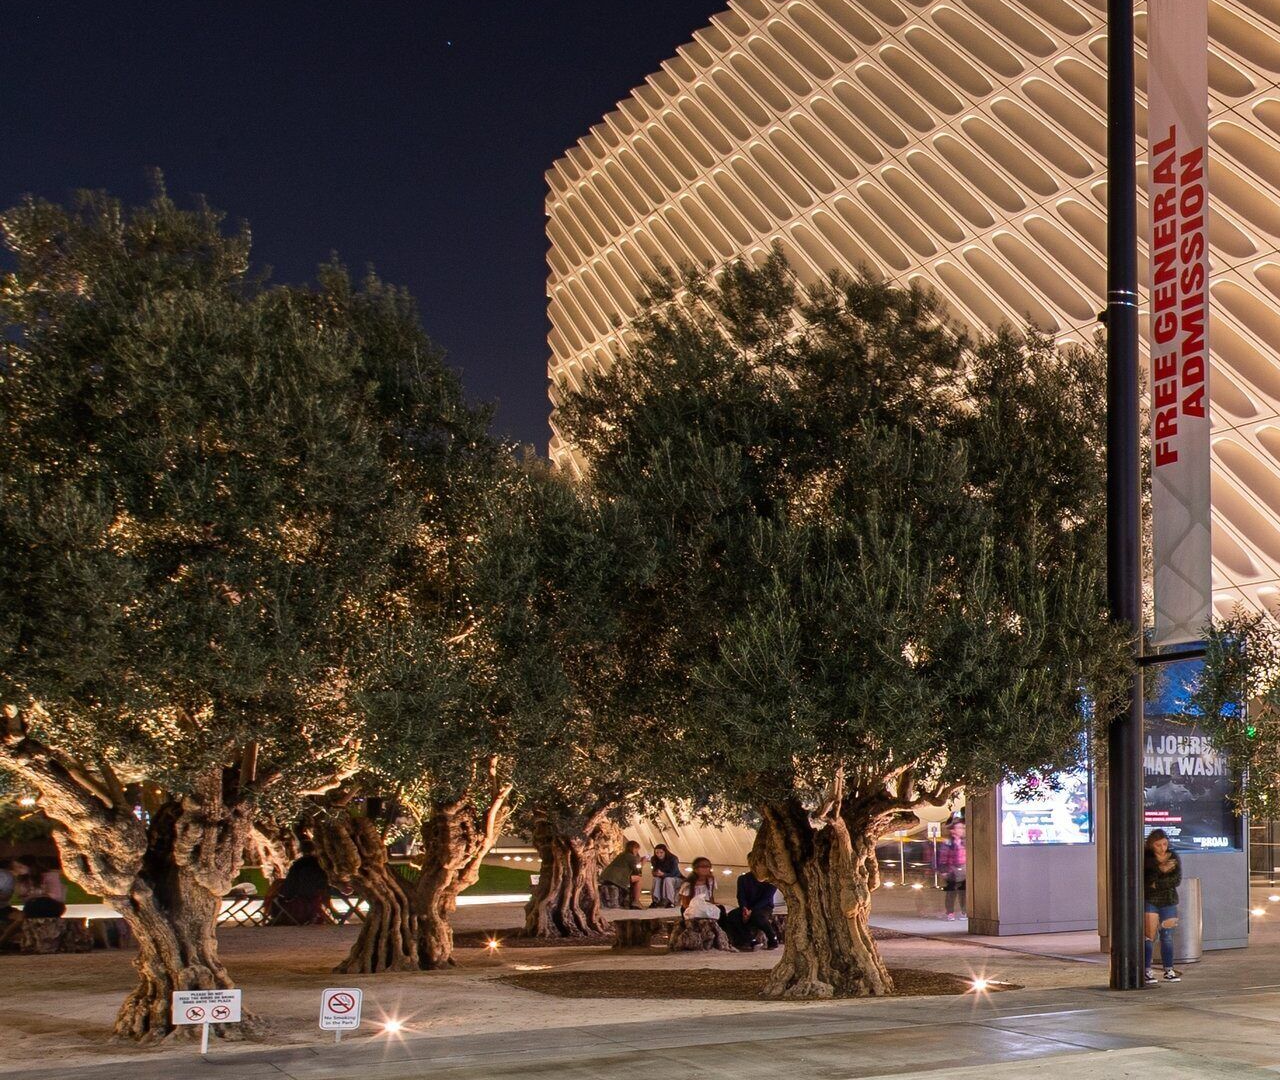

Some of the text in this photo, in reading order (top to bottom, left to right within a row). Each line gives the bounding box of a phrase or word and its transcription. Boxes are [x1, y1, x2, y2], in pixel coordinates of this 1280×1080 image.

[1153, 124, 1178, 467] FREE GENERAL
[1180, 146, 1206, 418] ADMISSION
[1146, 735, 1154, 754] A
[1201, 836, 1229, 847] BROAD
